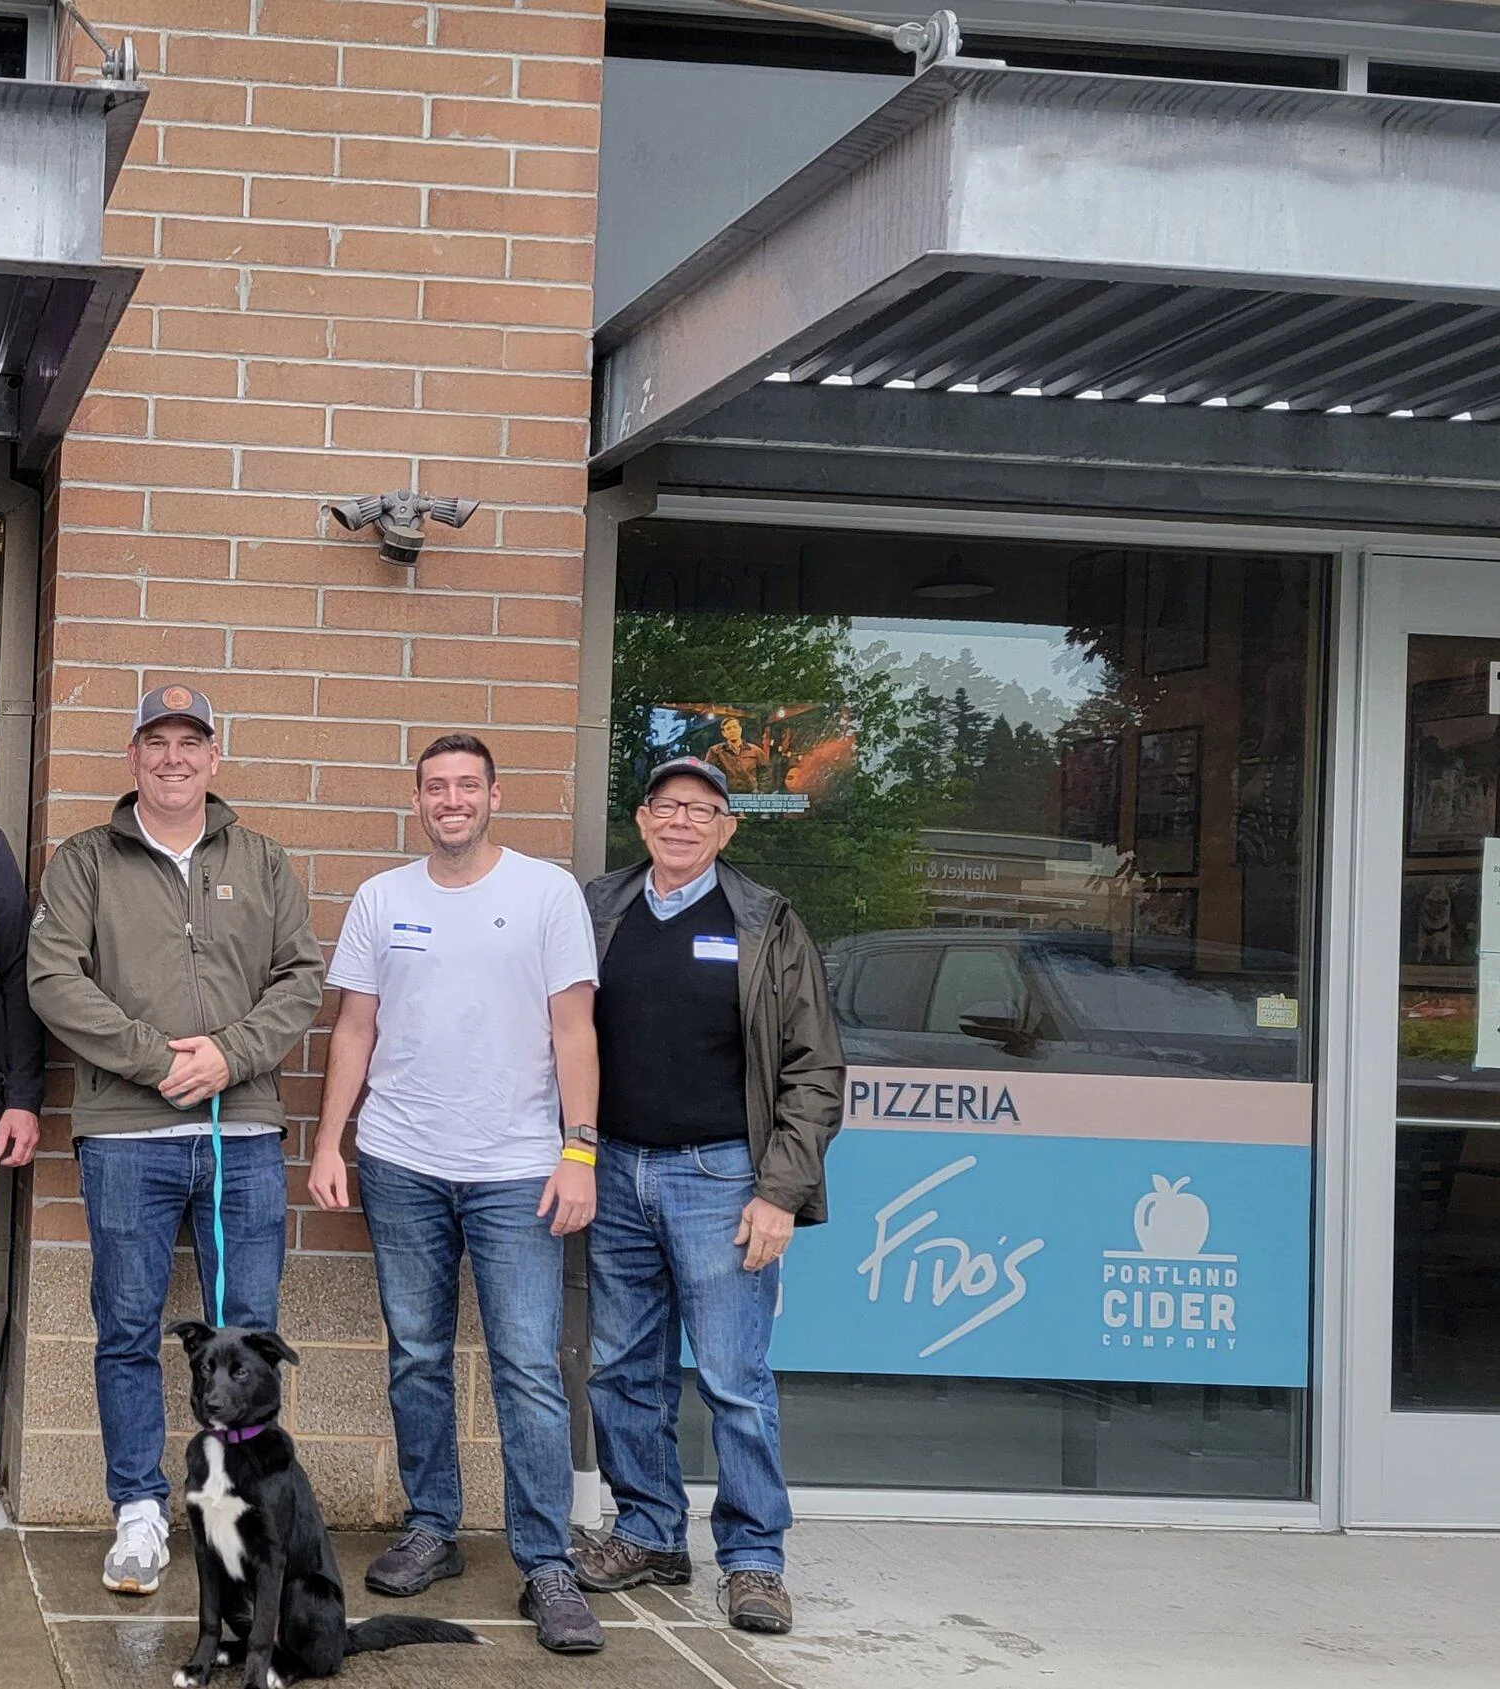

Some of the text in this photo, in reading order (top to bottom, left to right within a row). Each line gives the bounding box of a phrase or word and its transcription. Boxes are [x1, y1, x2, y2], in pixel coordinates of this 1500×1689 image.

[849, 1080, 1021, 1123] PIZZERIA
[1102, 1263, 1239, 1288] PORTLAND
[1102, 1288, 1238, 1332] CIDER
[1102, 1333, 1238, 1350] COMPANY
